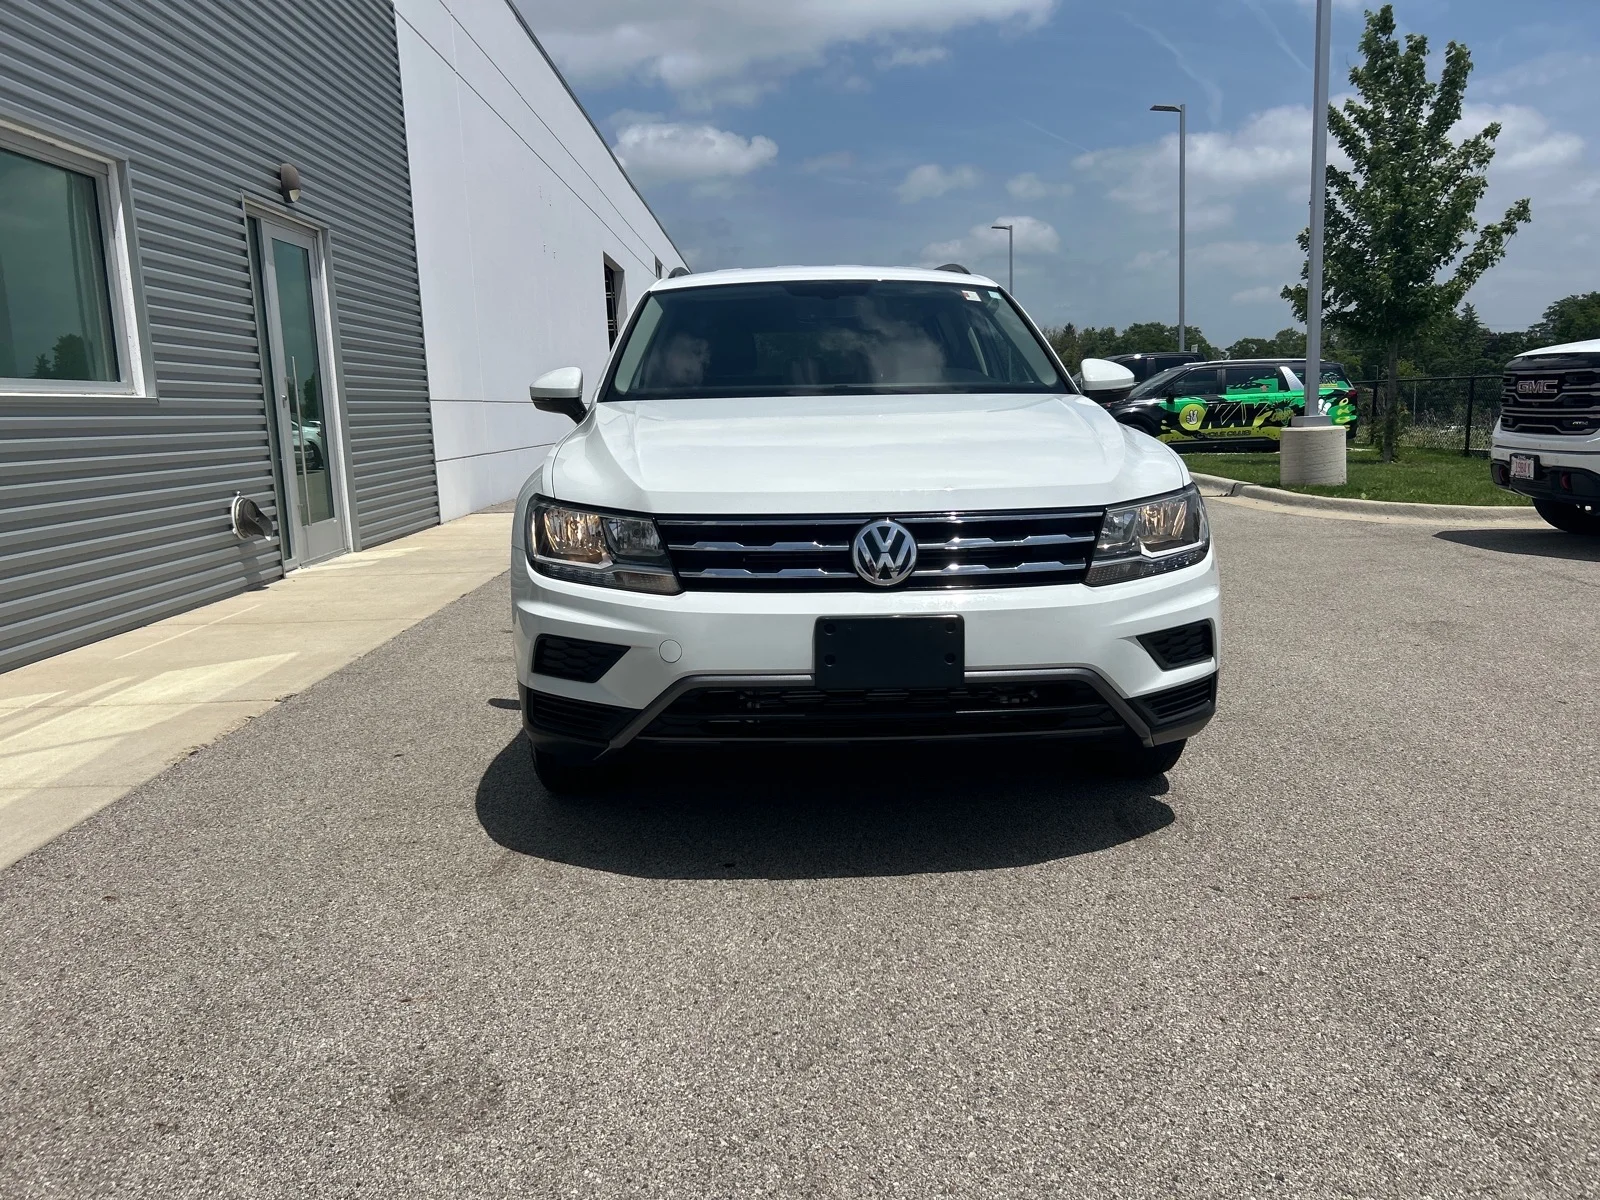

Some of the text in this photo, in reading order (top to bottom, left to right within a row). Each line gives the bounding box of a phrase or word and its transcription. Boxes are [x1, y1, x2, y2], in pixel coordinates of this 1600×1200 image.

[1516, 379, 1559, 394] GMC
[1226, 429, 1252, 437] CLUB
[853, 520, 917, 586] VW
